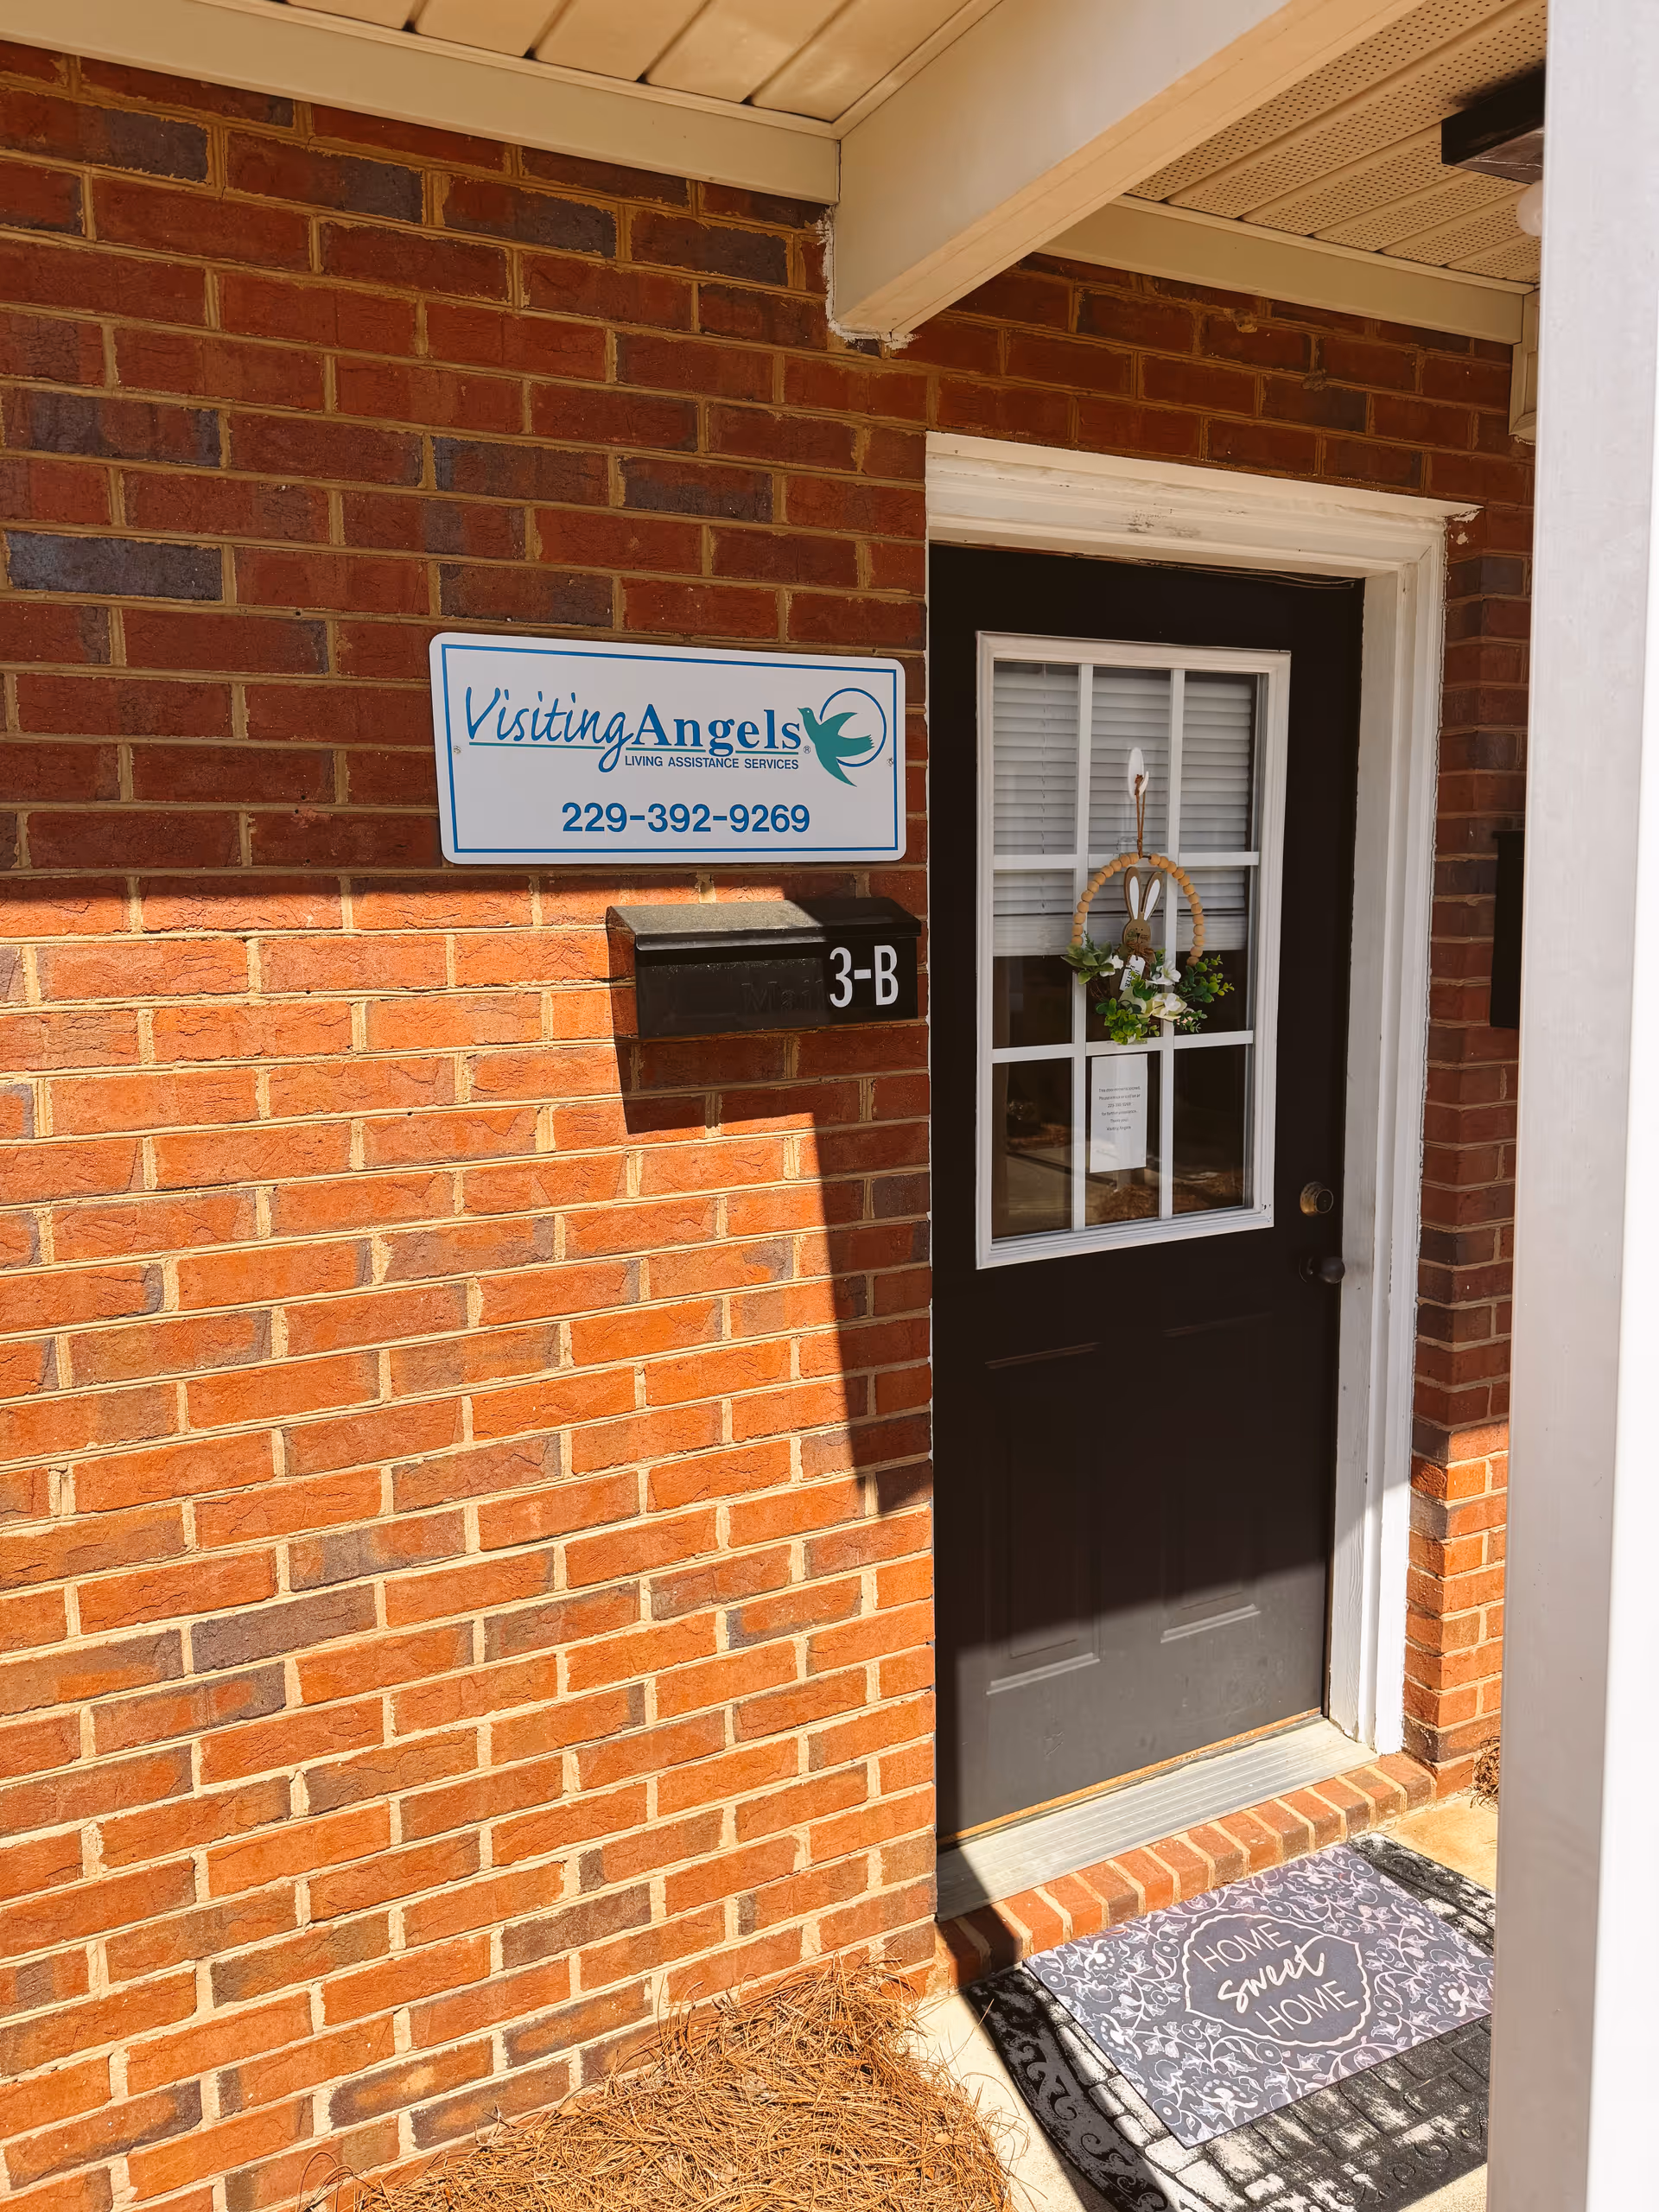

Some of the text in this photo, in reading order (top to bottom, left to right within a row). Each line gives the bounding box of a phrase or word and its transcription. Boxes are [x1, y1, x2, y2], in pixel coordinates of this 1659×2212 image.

[465, 686, 802, 773] Visiting Angels
[625, 755, 799, 770] LIVING ASSISTANCE SERVICES
[562, 802, 810, 833] 229-392-9269
[829, 944, 899, 1008] 3-B
[1192, 1921, 1294, 1974] HOME
[1255, 1979, 1359, 2037] HOME
